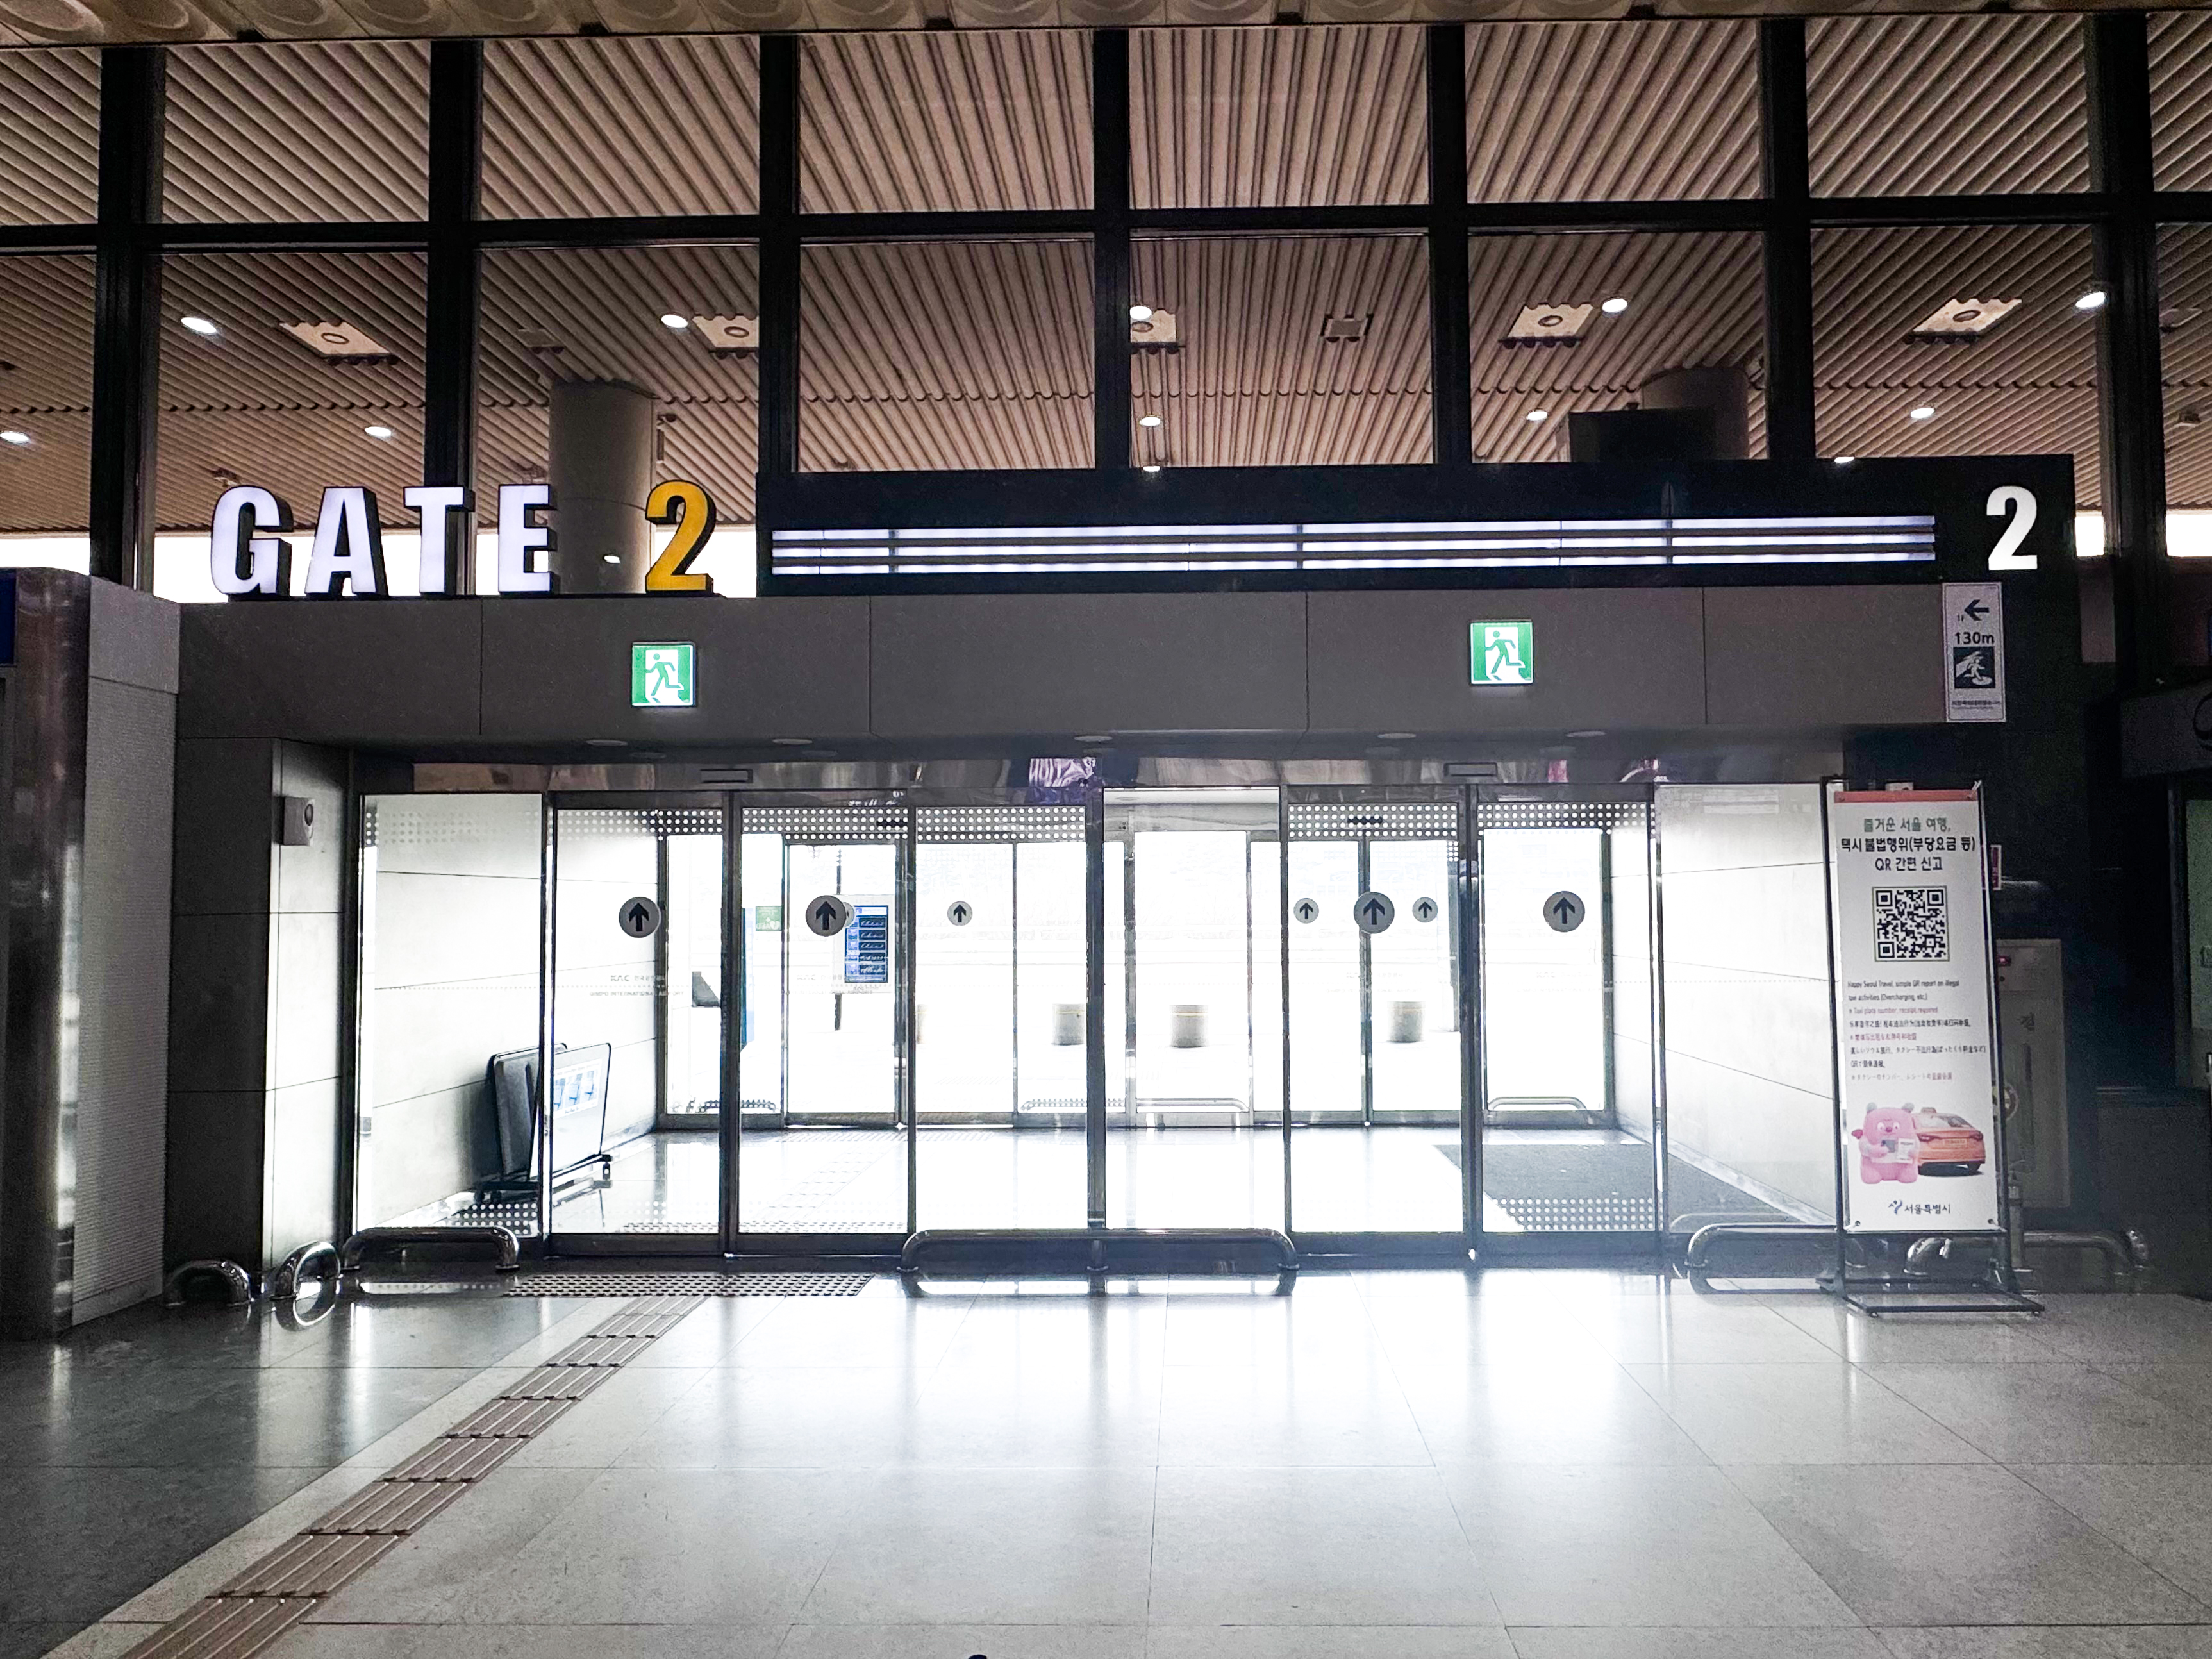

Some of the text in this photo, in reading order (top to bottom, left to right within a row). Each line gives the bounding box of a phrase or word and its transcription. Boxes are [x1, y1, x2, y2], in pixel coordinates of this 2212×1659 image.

[1986, 485, 2038, 571] 2
[210, 479, 715, 596] GATE 2
[1954, 631, 1995, 645] 130m
[1863, 817, 1951, 833] 즐거운 서울 여행,
[1841, 837, 1862, 853] 택시
[1961, 836, 1975, 852] 등)
[1875, 856, 1943, 872] QR 간편 신고
[1904, 1203, 1951, 1215] 서울특별시
